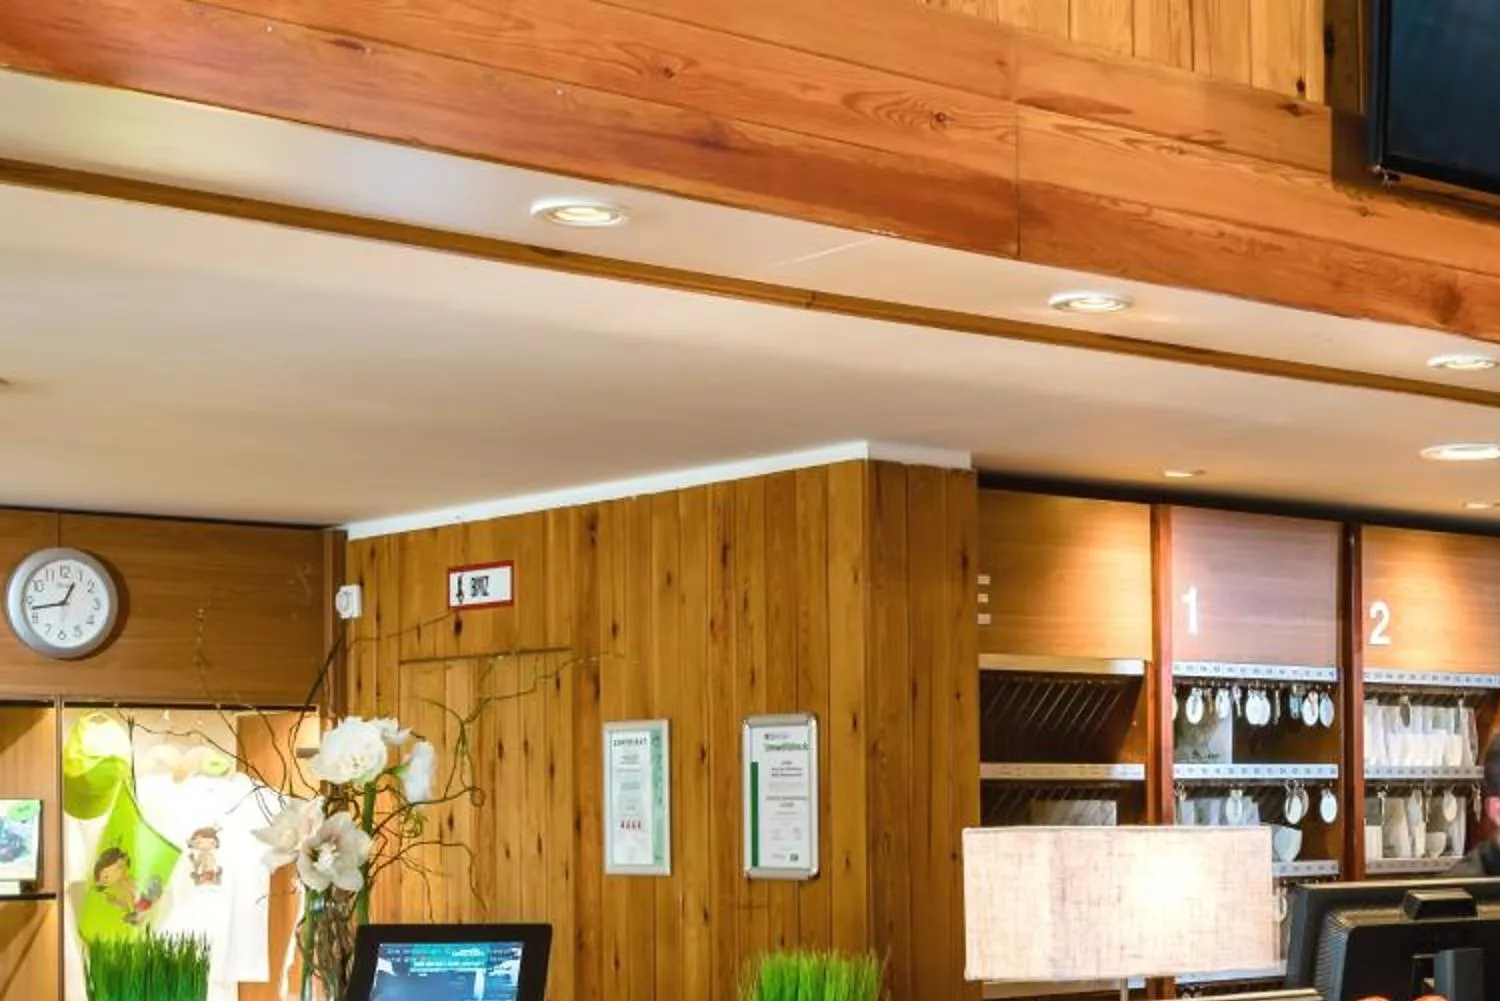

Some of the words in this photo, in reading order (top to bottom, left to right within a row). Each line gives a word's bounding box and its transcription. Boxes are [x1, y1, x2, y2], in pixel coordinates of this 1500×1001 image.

[45, 568, 55, 582] 11
[60, 565, 71, 579] 12
[32, 579, 45, 593] 10
[87, 579, 95, 593] 2
[93, 597, 101, 611] 3
[1181, 586, 1198, 634] 1
[45, 623, 52, 636] 7
[1367, 600, 1392, 646] 2
[57, 629, 67, 640] 6
